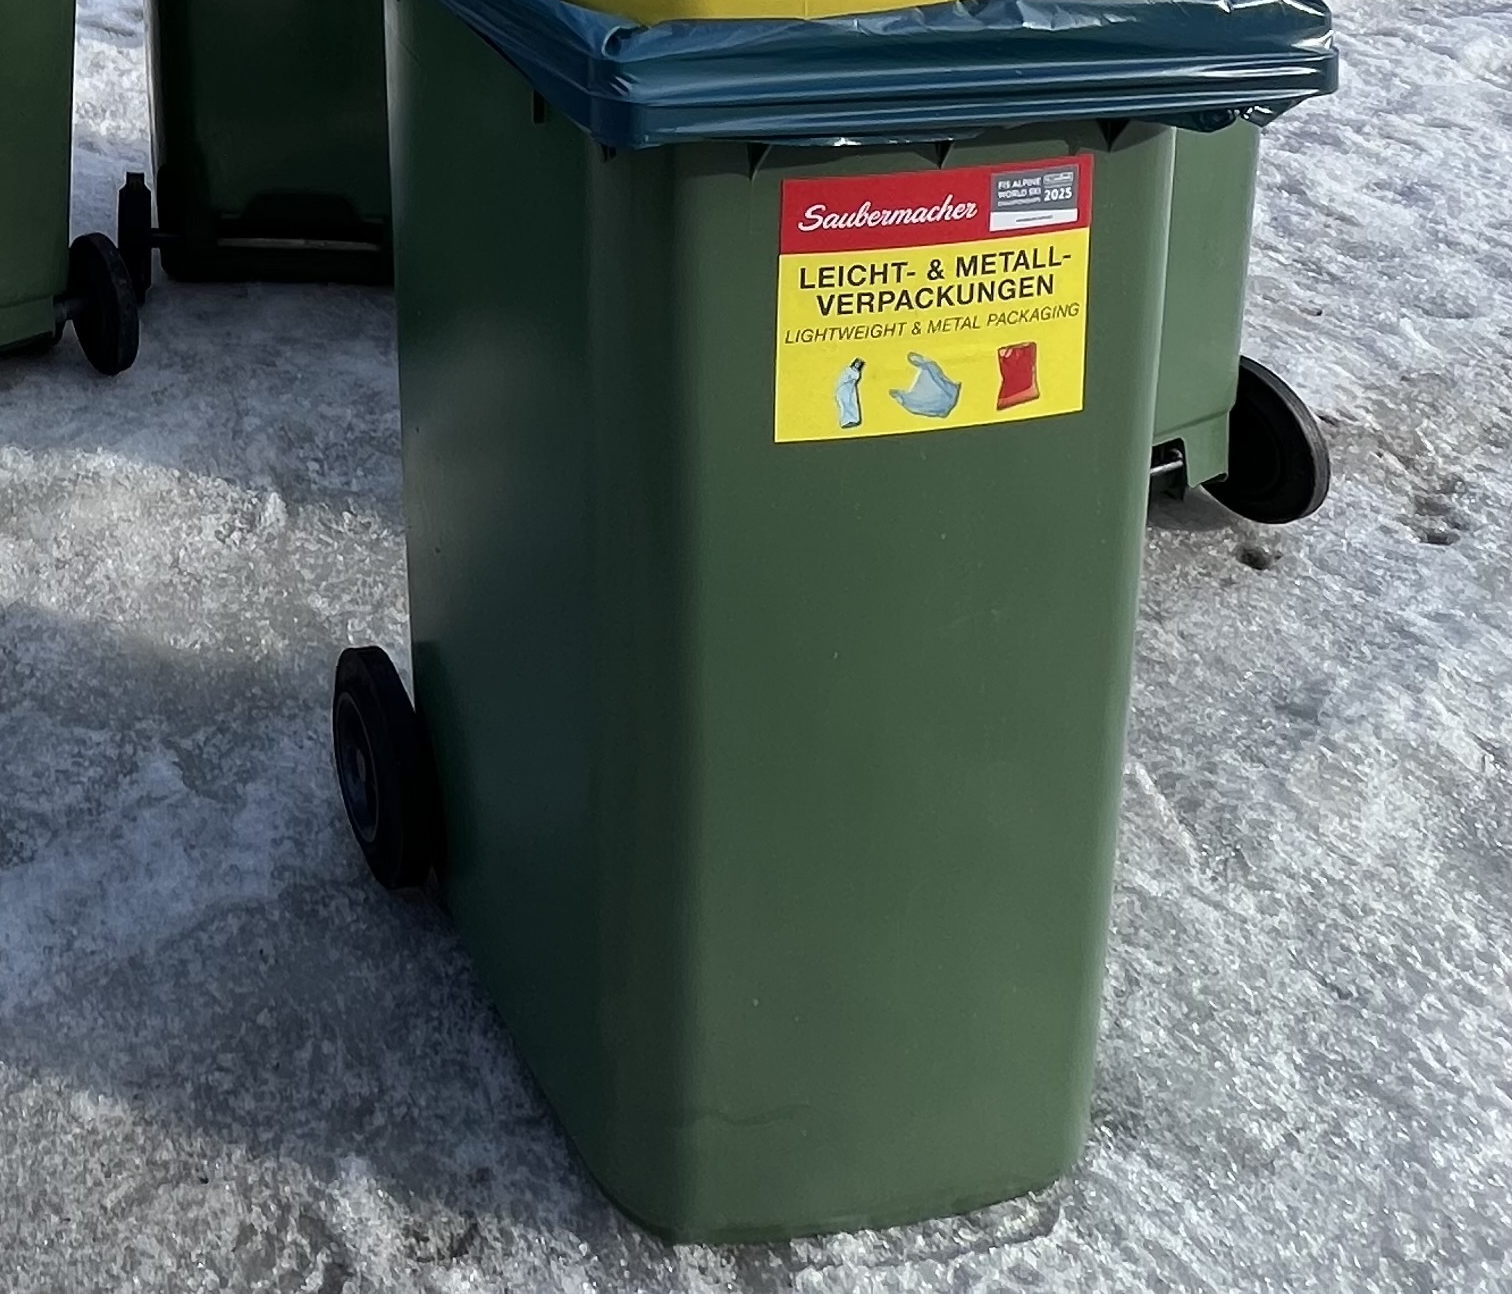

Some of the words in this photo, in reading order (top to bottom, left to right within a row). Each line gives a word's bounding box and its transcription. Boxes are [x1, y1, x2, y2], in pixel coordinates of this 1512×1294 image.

[797, 194, 977, 232] Saubermacher
[1044, 187, 1072, 202] 2025
[799, 262, 916, 289] LEICHT-
[926, 259, 945, 281] &
[956, 246, 1072, 278] METALL-
[816, 274, 1054, 316] VERPACKUNGEN
[785, 322, 908, 345] LIGHTWEIGHT
[911, 322, 922, 336] &
[927, 316, 981, 334] METAL
[987, 302, 1080, 327] PACKAGING
